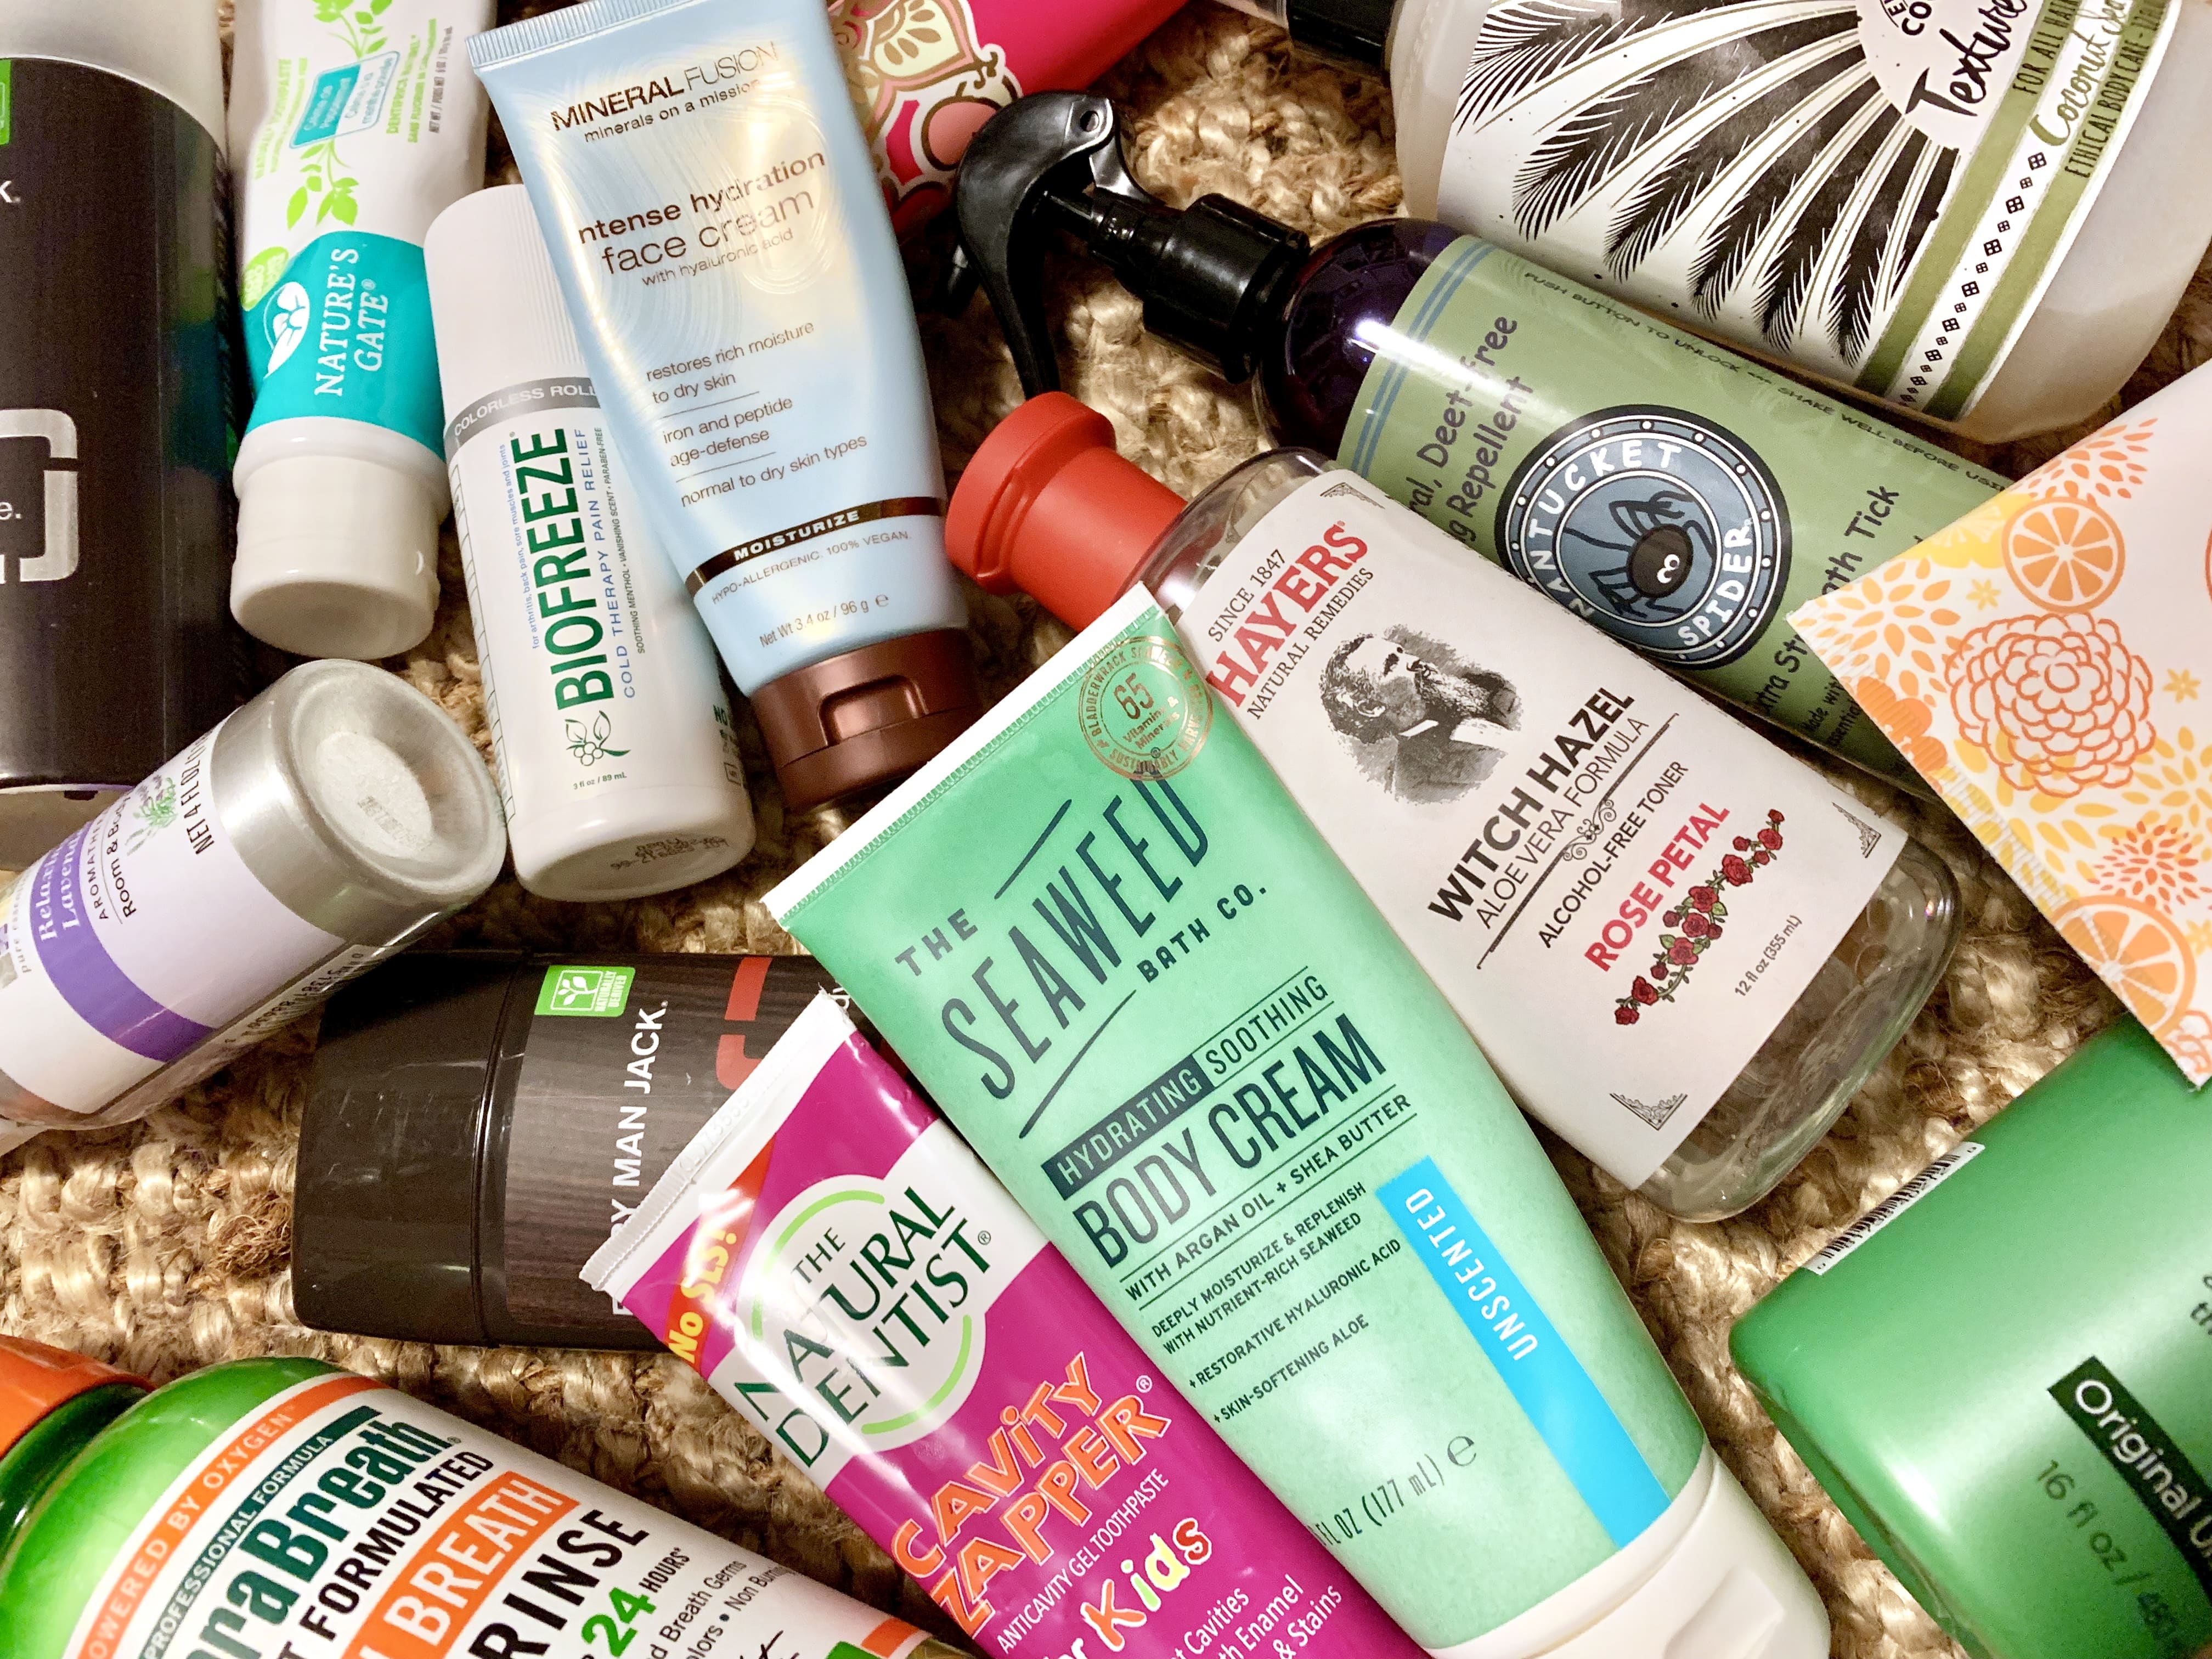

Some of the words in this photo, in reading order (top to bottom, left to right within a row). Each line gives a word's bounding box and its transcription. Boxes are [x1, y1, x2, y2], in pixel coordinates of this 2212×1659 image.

[1905, 0, 2027, 117] Texture
[2013, 63, 2050, 94] FOR
[2030, 31, 2064, 60] ALL
[584, 114, 654, 142] minerals
[659, 105, 680, 120] on
[685, 101, 695, 111] a
[2064, 114, 2117, 178] ETHICAL
[2097, 73, 2135, 112] BODY
[691, 151, 825, 212] hydration
[602, 236, 686, 274] face
[699, 190, 814, 250] cream
[642, 268, 676, 286] with
[680, 243, 758, 276] hyaluronic
[763, 229, 793, 250] acid
[314, 249, 359, 396] NATURE'S
[647, 354, 712, 381] restores
[716, 345, 744, 364] rich
[748, 321, 814, 355] moisture
[1572, 293, 1640, 326] BUTTON
[1647, 325, 1669, 340] TO
[1777, 386, 1835, 415] SHAKE
[454, 386, 545, 436] COLORLESS
[653, 390, 669, 404] to
[674, 382, 698, 398] dry
[704, 373, 736, 391] skin
[663, 426, 694, 444] iron
[699, 416, 729, 434] and
[735, 397, 793, 428] peptide
[500, 444, 510, 469] joints
[574, 430, 595, 490] RELIEF
[670, 428, 769, 467] age-defense
[681, 477, 735, 507] normal
[740, 474, 755, 488] to
[761, 466, 785, 483] dry
[790, 453, 820, 472] skin
[825, 435, 867, 460] types
[1446, 376, 1533, 518] Repellent
[507, 489, 518, 524] muscles
[588, 500, 605, 541] PAIN
[612, 518, 627, 562] VANISHING
[734, 510, 860, 562] MOISTURIZE
[1844, 486, 1900, 539] Tick
[510, 428, 614, 710] BIOFREEZE
[521, 571, 530, 593] back
[826, 539, 860, 556] 100%
[1678, 518, 1752, 647] SPIDER
[597, 550, 623, 636] THERAPY
[623, 568, 637, 606] MENTHOL
[1207, 587, 1254, 642] SINCE
[1250, 549, 1285, 588] 1847
[630, 609, 646, 654] SOOTHING
[759, 631, 777, 648] Net
[777, 623, 793, 637] Wt
[794, 616, 815, 631] 3.4
[817, 610, 831, 622] oz
[840, 600, 857, 616] 96
[1246, 642, 1310, 720] NATURAL
[1304, 567, 1374, 641] REMEDIES
[617, 645, 635, 698] COLD
[1113, 673, 1155, 719] 65
[180, 760, 201, 786] OZ
[180, 780, 199, 806] FL
[1427, 786, 1543, 923] WITCH
[1526, 686, 1635, 793] HAZEL
[184, 803, 201, 819] 4
[186, 819, 215, 855] NET
[1476, 861, 1528, 929] ALOE
[1516, 808, 1574, 866] VERA
[1564, 717, 1650, 808] FORMULA
[1538, 810, 1647, 948] ALCOHOL-FREE
[1636, 760, 1689, 825] TONER
[1583, 880, 1664, 972] ROSE
[1649, 802, 1730, 888] PETAL
[895, 908, 978, 977] THE
[941, 763, 1207, 1099] SEAWEED
[1137, 917, 1210, 983] BATH
[1216, 883, 1266, 920] CO.
[1735, 983, 1748, 997] 12
[1746, 969, 1758, 984] fl
[1754, 957, 1769, 973] oz
[1057, 1068, 1201, 1186] HYDRATING
[1205, 975, 1328, 1075] SOOTHING
[613, 1105, 647, 1186] MAN
[1072, 1127, 1217, 1268] BODY
[1207, 1013, 1386, 1170] CREAM
[1127, 1263, 1172, 1302] WITH
[1176, 1214, 1239, 1268] ARGAN
[1242, 1192, 1273, 1218] OIL
[1290, 1147, 1339, 1185] SHEA
[1337, 1094, 1410, 1151] BUTTER
[792, 1227, 845, 1284] THE
[1152, 1302, 1199, 1339] DEEPLY
[1201, 1242, 1283, 1305] MOISTURIZE
[1294, 1182, 1367, 1237] REPLENISH
[1163, 1329, 1195, 1355] WITH
[1194, 1255, 1299, 1336] NUTRIENT-RICH
[1301, 1212, 1361, 1261] SEAWEED
[1286, 1260, 1371, 1323] HYALURONIC
[1372, 1238, 1402, 1269] ACID
[1404, 1188, 1538, 1362] UNSCENTED
[668, 1312, 704, 1363] No
[1331, 1313, 1369, 1349] ALOE
[2075, 1378, 2202, 1521] Original
[168, 1496, 201, 1532] BY
[1338, 1507, 1363, 1540] OZ
[1362, 1478, 1406, 1526] (177
[1408, 1452, 1445, 1497] mL)
[2036, 1459, 2075, 1500] 16
[2066, 1500, 2098, 1528] fl
[2089, 1532, 2128, 1572] oz
[143, 1508, 257, 1659] PROFESSIONAL
[253, 1435, 334, 1504] FORMULA
[300, 1452, 494, 1643] FORMULATED
[385, 1480, 562, 1646] BREATH
[996, 1569, 1073, 1654] ANTICAVITY
[1069, 1545, 1099, 1577] GEL
[1091, 1469, 1169, 1556] TOOTHPASTE
[469, 1509, 650, 1659] RINSE
[659, 1585, 714, 1642] Breath
[708, 1560, 747, 1590] Germs
[725, 1585, 752, 1612] Non
[1080, 1517, 1212, 1652] Kids
[1237, 1574, 1304, 1644] Enamel
[1285, 1585, 1342, 1646] Stains
[582, 1587, 657, 1657] 24
[1184, 1587, 1250, 1654] Cavities
